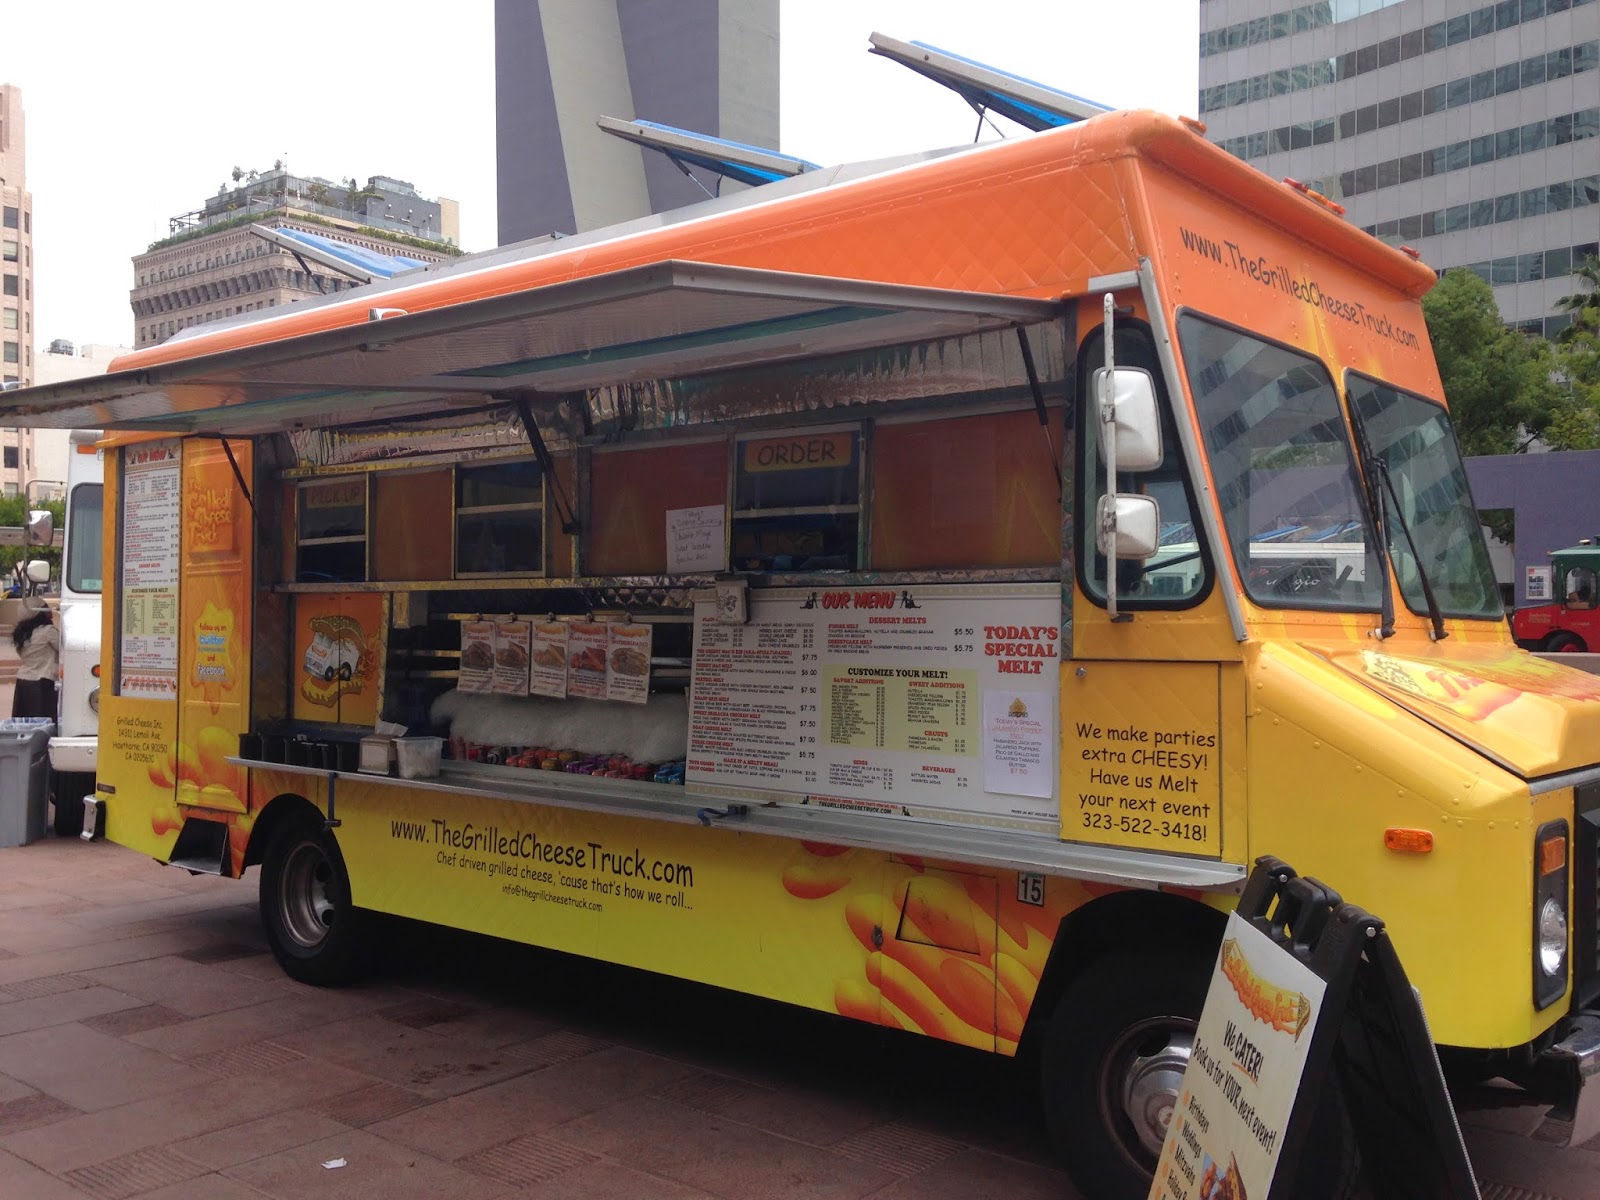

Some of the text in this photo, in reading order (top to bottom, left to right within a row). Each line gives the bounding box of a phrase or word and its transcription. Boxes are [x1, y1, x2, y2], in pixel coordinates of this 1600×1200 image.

[1179, 226, 1420, 350] www.TheGrilledCheeseTruck.com
[757, 440, 836, 466] ORDER
[822, 592, 896, 609] OUR MENU
[902, 617, 927, 625] MELTS
[954, 628, 974, 636] $5.50
[984, 625, 1058, 641] TODAY'S
[954, 645, 974, 653] $5.75
[984, 643, 1058, 658] SPECIAL
[197, 662, 225, 677] facebook
[847, 667, 949, 679] CUSTOMIZE YOUR MELT!
[997, 660, 1044, 675] MELT
[116, 716, 134, 726] Grilled
[134, 717, 152, 728] Cheese
[1075, 722, 1216, 748] We make parties
[125, 751, 133, 761] CA
[142, 742, 150, 752] CA
[799, 751, 815, 759] $5.75
[922, 766, 956, 774] BEVERAGES
[1081, 748, 1208, 771] extra CHEESY!
[1090, 768, 1199, 794] Have us Melt
[818, 801, 892, 815] THEGRILLEDCHEESETRUCK.COM
[1078, 793, 1211, 819] your next event
[1082, 811, 1208, 842] 323-522-3418!
[391, 818, 694, 888] www.TheGrilledCheeseTruck.com
[436, 850, 694, 910] Chef driven grilled cheese, 'cause that's how we roll...
[1020, 877, 1042, 903] 15
[501, 883, 603, 912] info@thegrillcheesetruck.com
[1223, 1019, 1264, 1083] We CATER!
[1193, 1037, 1277, 1156] Book us for YOUR next event!
[1188, 1095, 1210, 1135] Birthdays
[1181, 1119, 1203, 1160] Weddings
[1174, 1143, 1197, 1187] Mitzvahs
